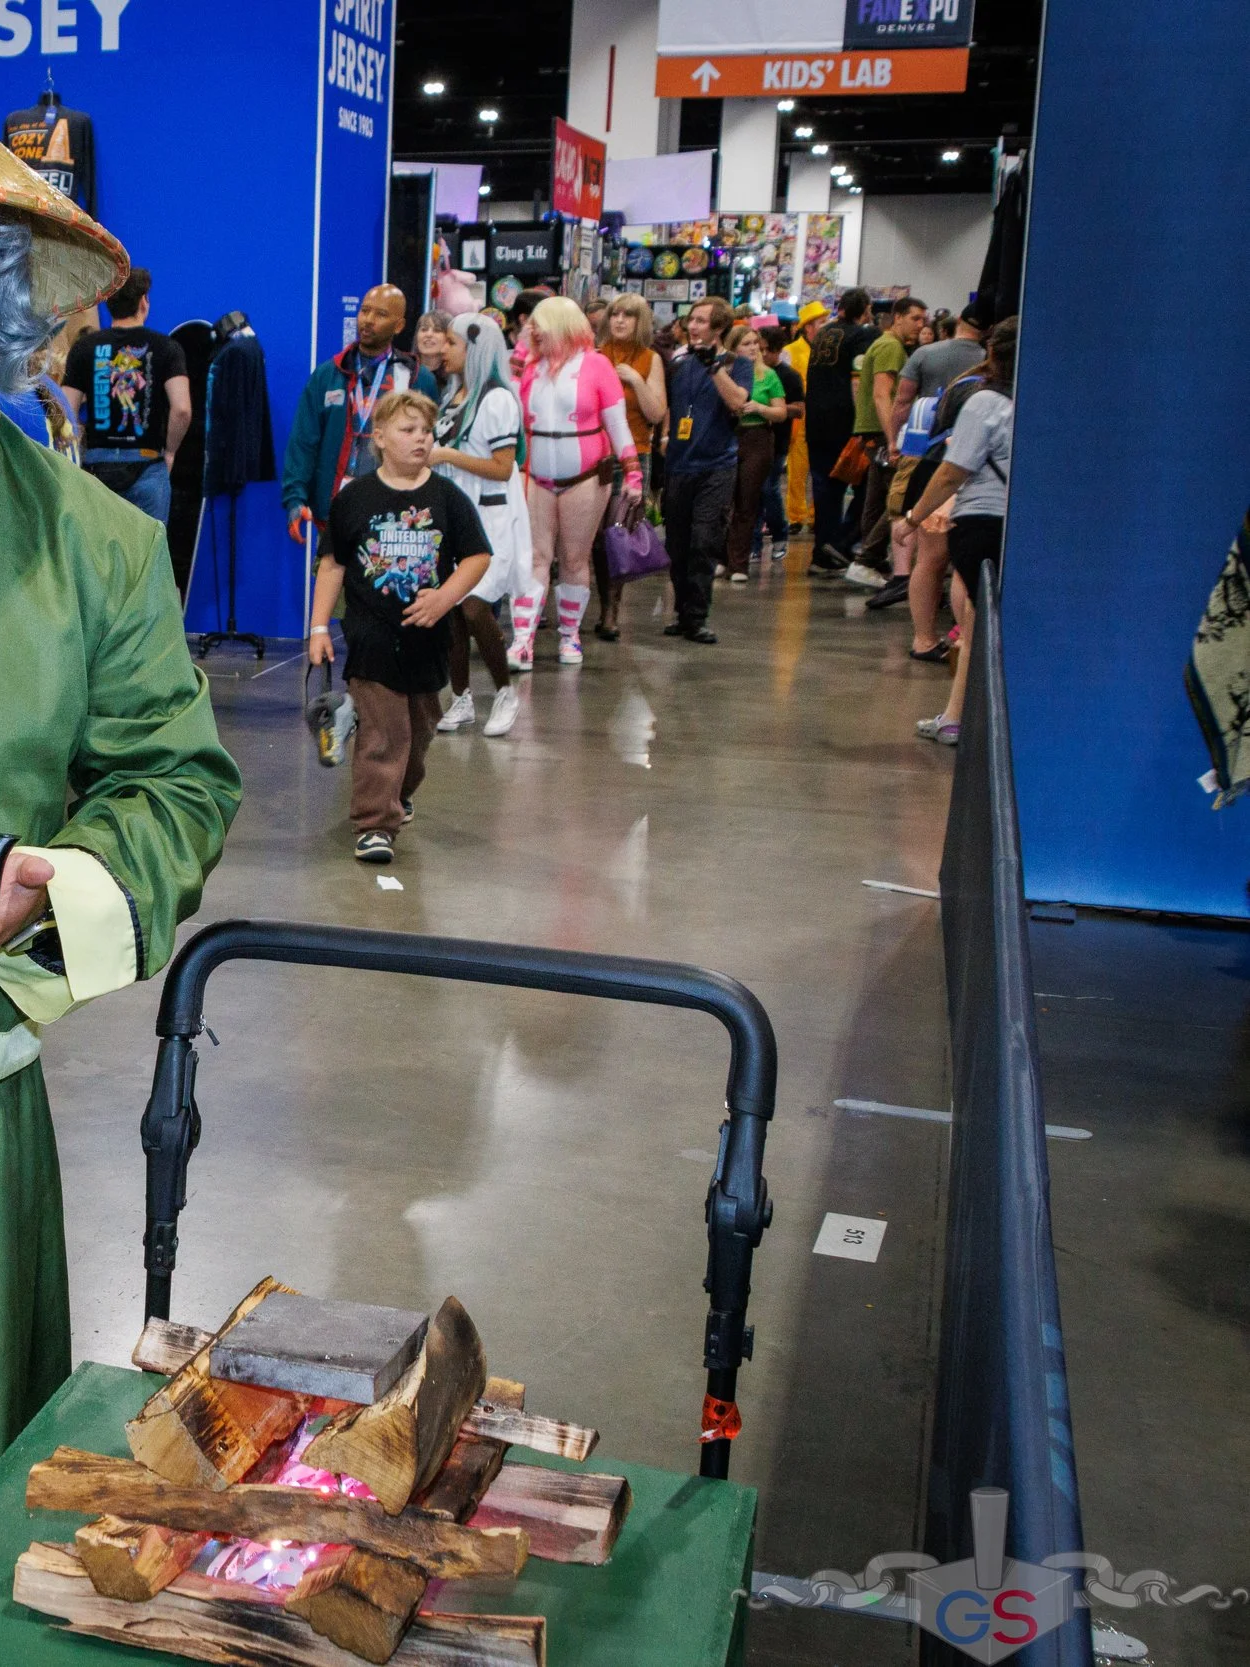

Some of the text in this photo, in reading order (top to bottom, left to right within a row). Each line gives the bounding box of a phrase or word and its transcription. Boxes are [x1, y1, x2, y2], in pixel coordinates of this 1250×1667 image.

[876, 23, 936, 34] DENVER
[328, 29, 386, 103] JERSEY
[839, 58, 892, 88] LAB
[338, 106, 358, 133] SINCE
[11, 132, 46, 147] COZY
[14, 146, 44, 160] ONE
[495, 244, 548, 262] Thug Life
[379, 530, 430, 544] UNITED BY
[379, 543, 428, 558] FANDOM
[842, 1228, 865, 1245] 513
